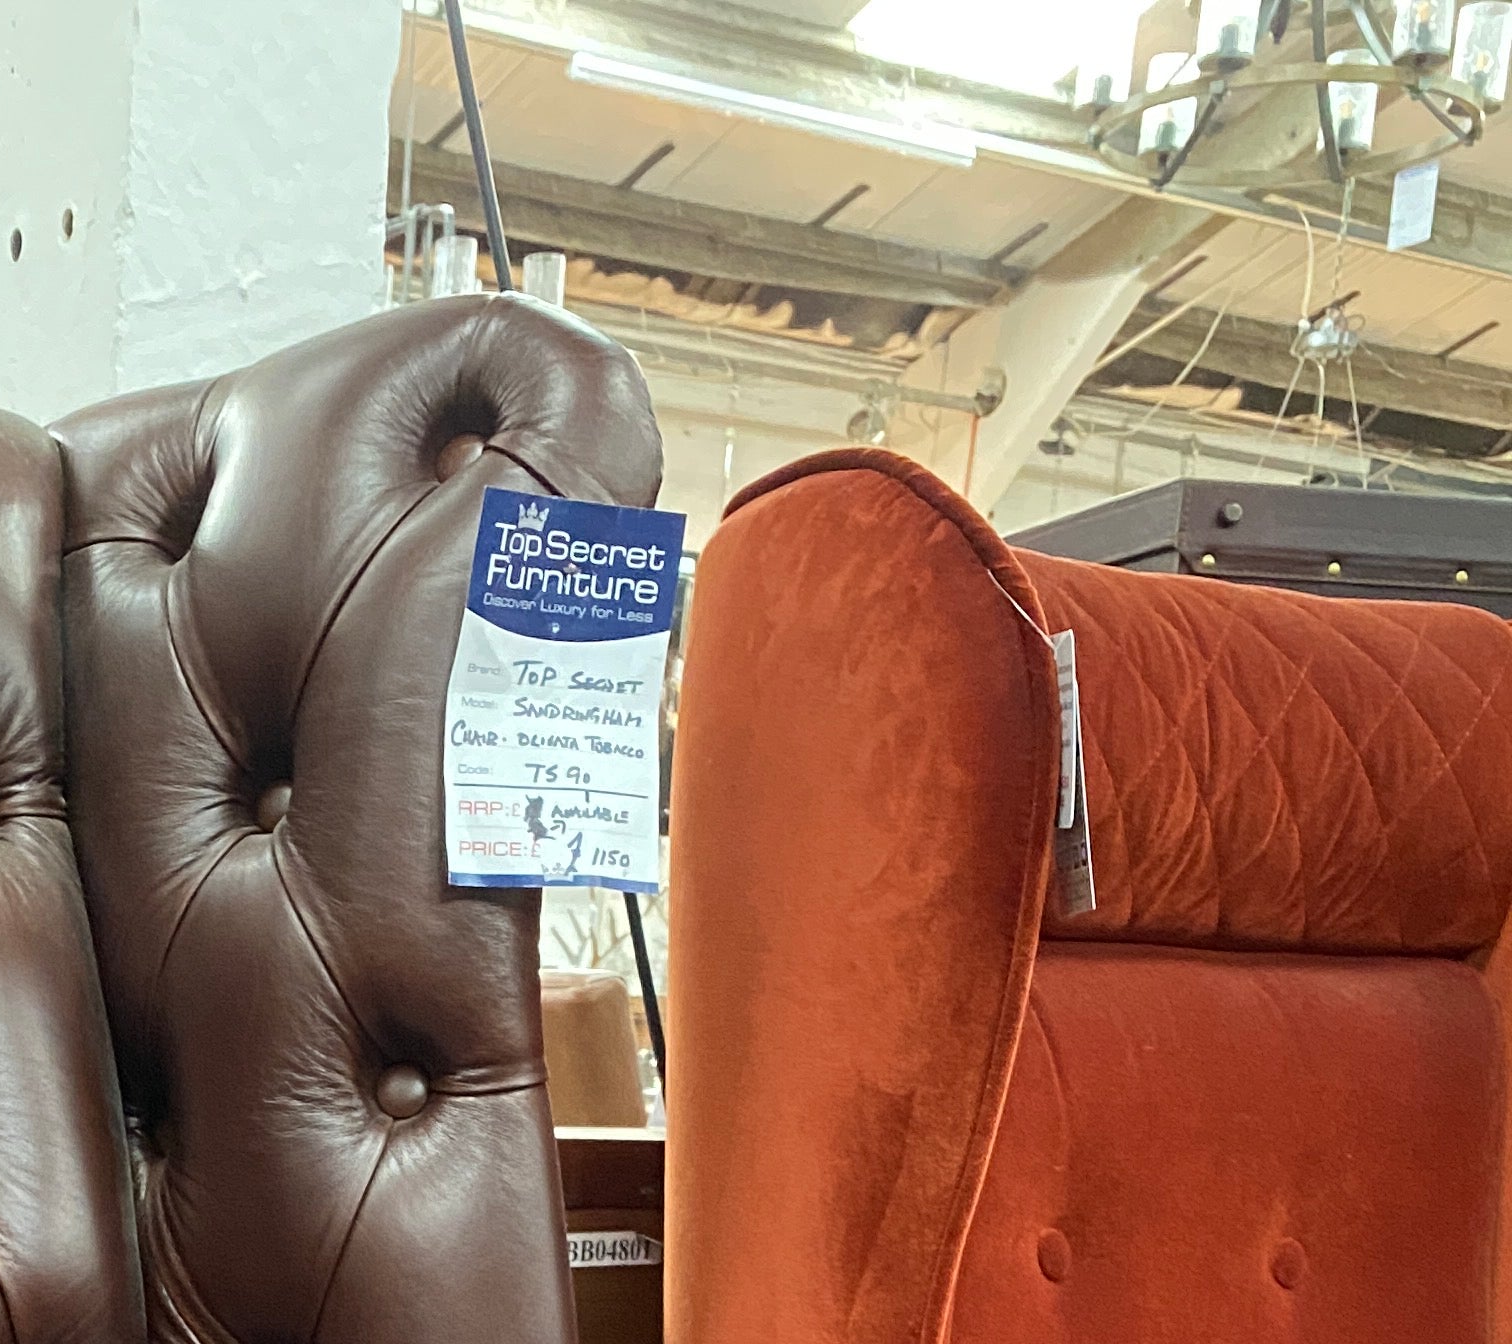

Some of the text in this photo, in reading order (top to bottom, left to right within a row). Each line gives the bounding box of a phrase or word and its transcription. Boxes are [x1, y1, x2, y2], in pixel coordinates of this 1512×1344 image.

[486, 552, 660, 605] Furniture
[483, 592, 654, 624] Discover Luxury for Less
